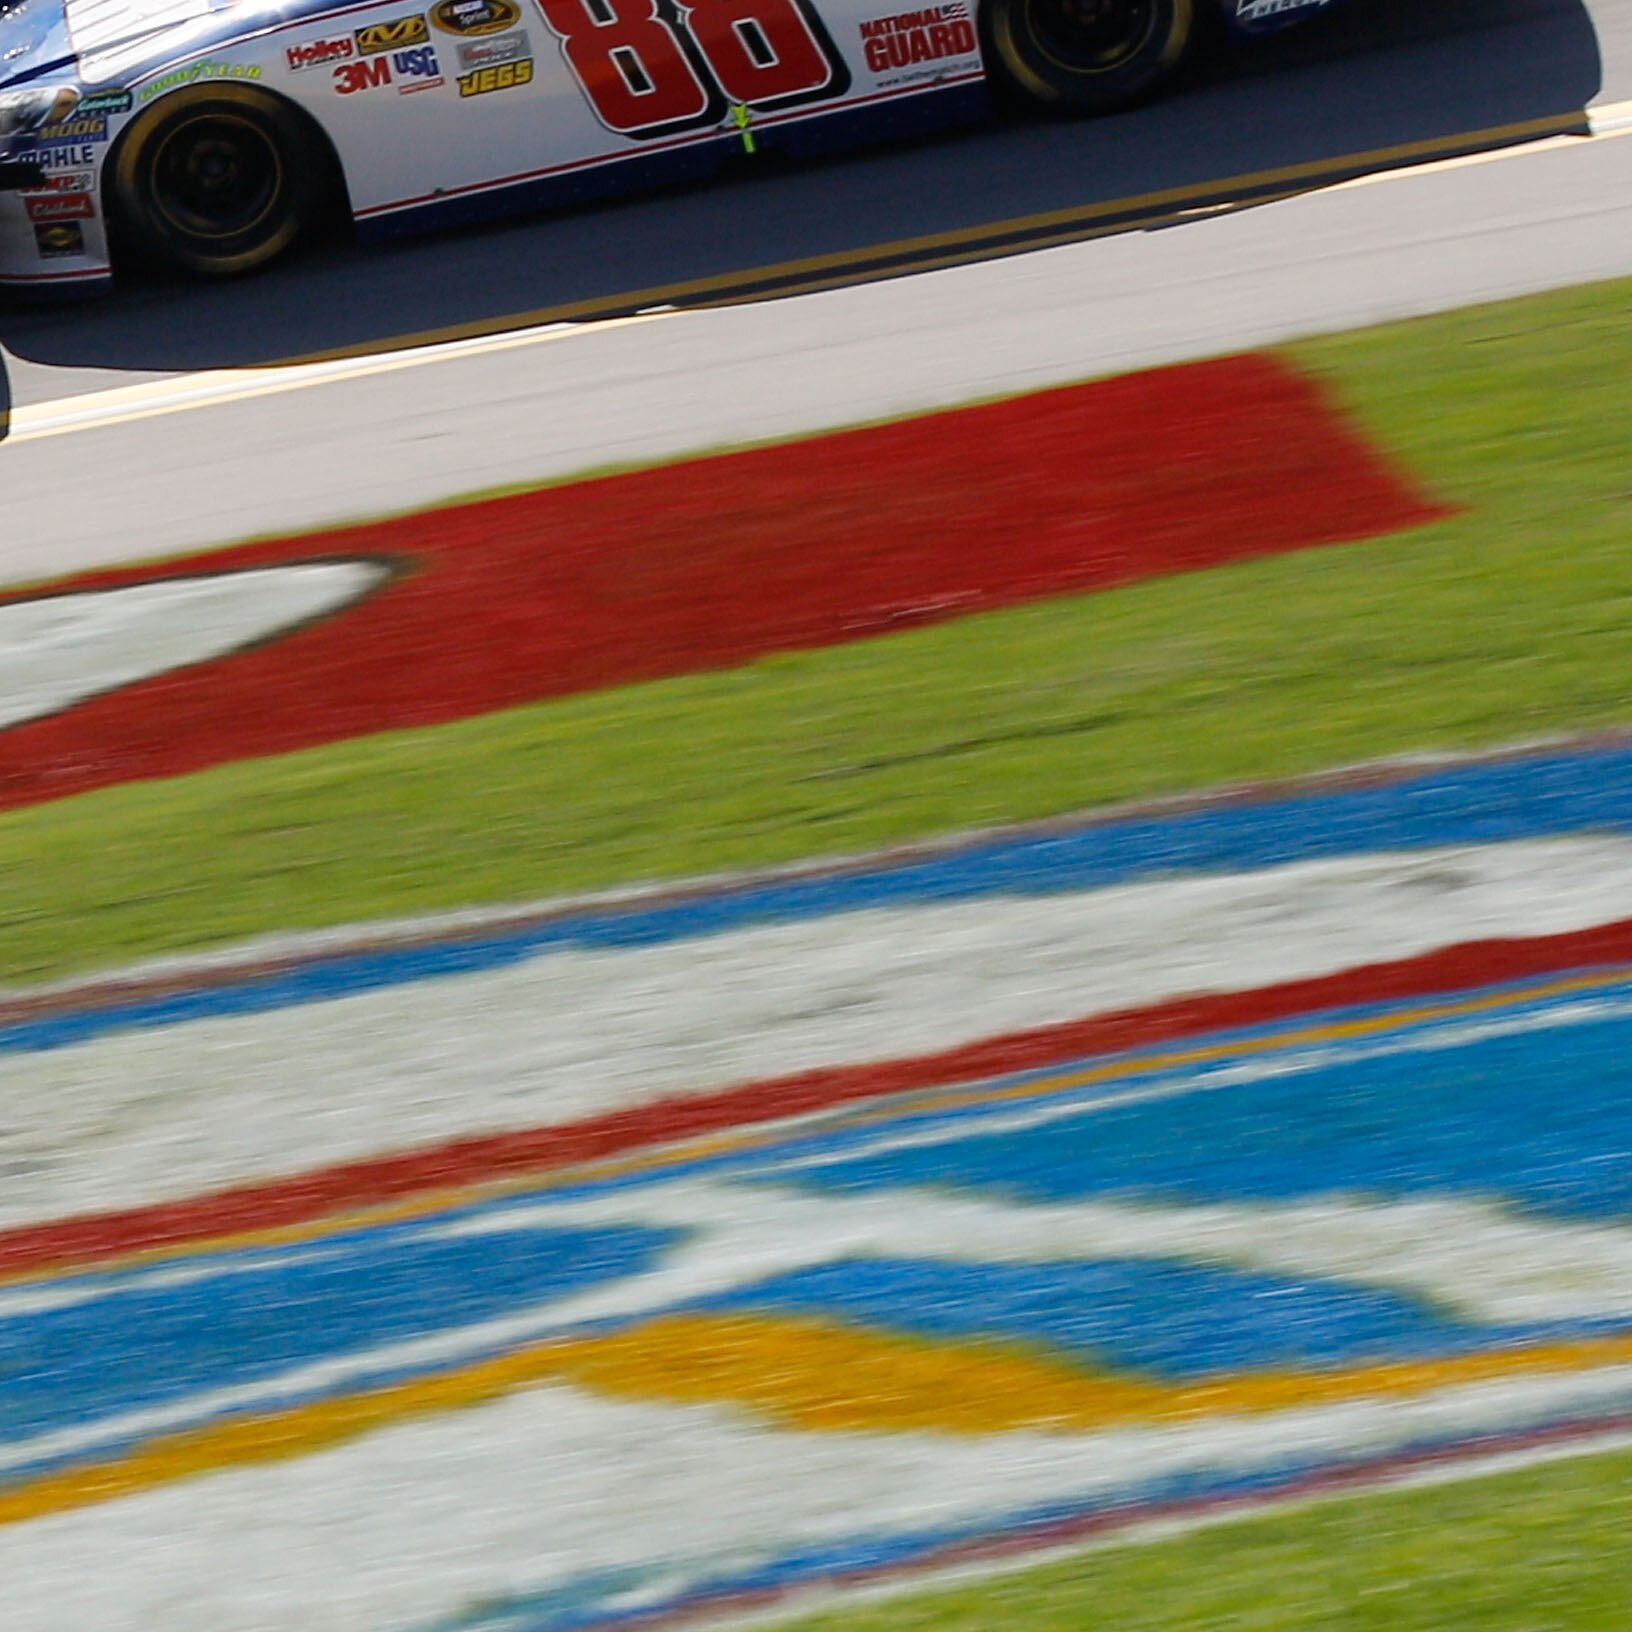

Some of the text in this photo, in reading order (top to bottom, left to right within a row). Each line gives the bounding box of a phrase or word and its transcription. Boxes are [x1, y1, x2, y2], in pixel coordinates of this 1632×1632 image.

[459, 8, 491, 25] Sprint
[859, 6, 943, 41] NATIONAL
[286, 36, 353, 64] Holley
[393, 46, 440, 76] USG
[862, 19, 977, 73] GUARD
[138, 60, 263, 103] GOODYEAR
[333, 56, 392, 95] 3M
[457, 57, 534, 98] JEGS
[39, 119, 104, 140] MOOG
[19, 145, 94, 168] MAHLE
